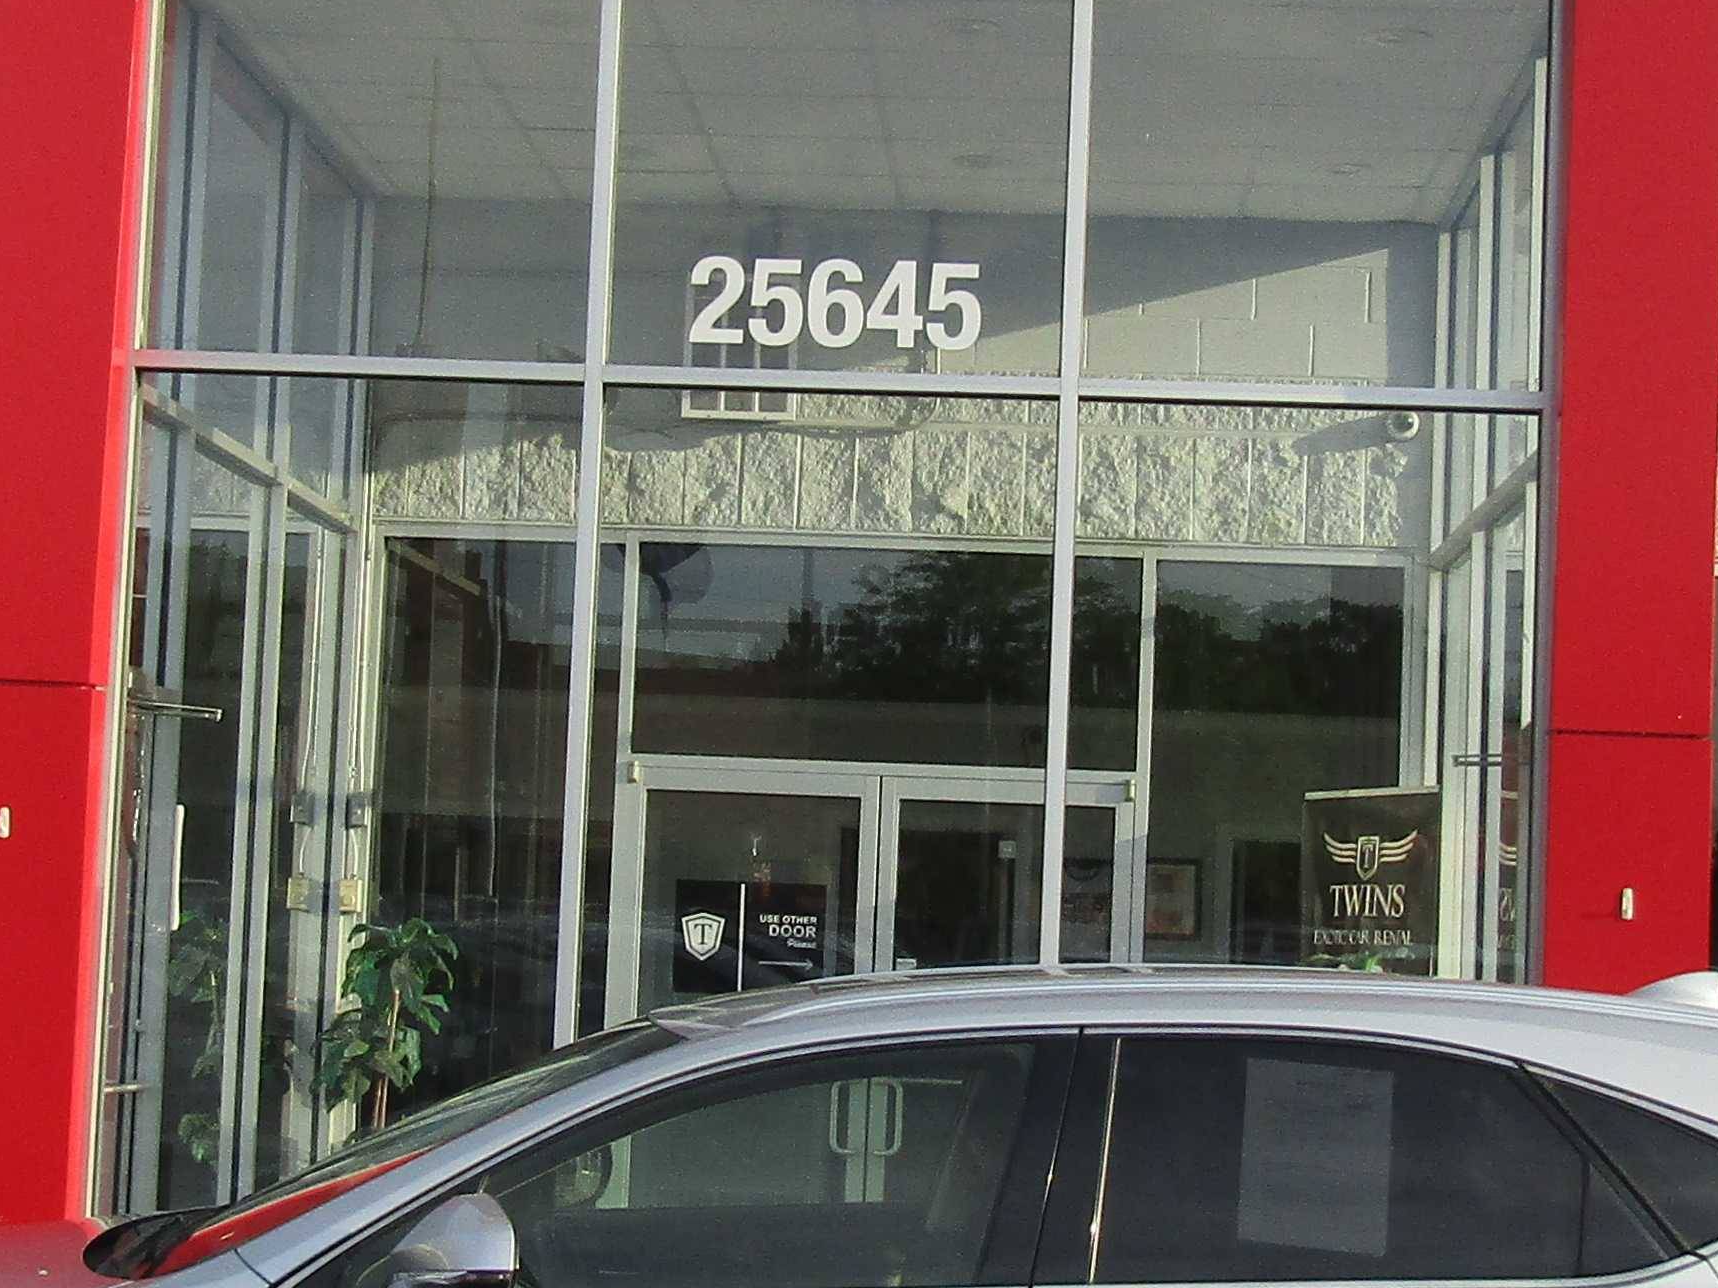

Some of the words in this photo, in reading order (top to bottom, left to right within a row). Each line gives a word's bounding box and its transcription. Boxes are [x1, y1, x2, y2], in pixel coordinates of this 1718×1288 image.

[687, 255, 982, 351] 25645
[1329, 884, 1406, 918] TWINS
[759, 914, 780, 924] USE
[782, 915, 818, 925] OTHER
[694, 923, 713, 945] T
[768, 924, 817, 938] DOOR
